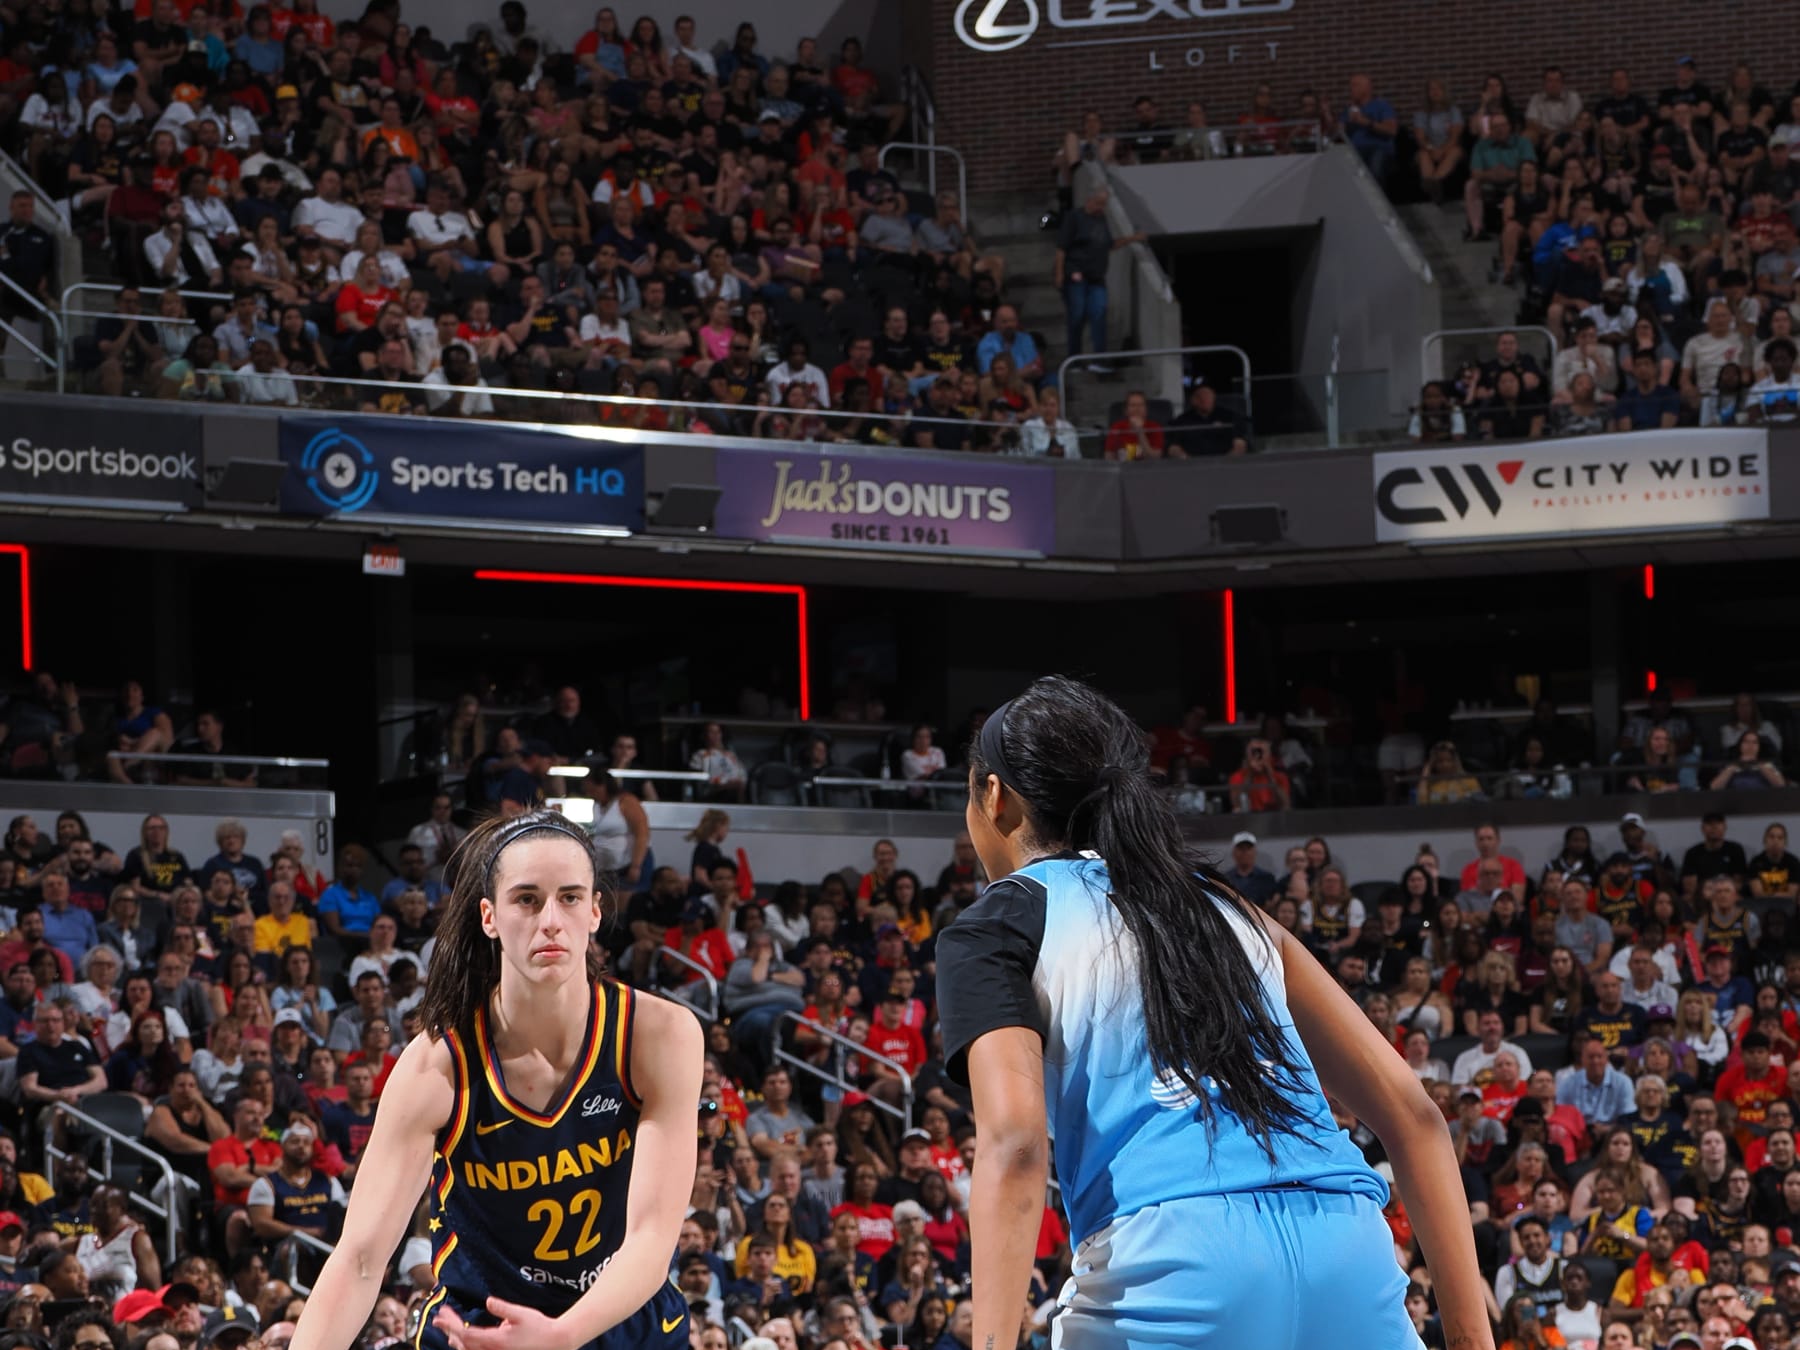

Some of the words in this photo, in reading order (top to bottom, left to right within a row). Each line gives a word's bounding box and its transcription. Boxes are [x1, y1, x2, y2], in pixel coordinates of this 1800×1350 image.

[1149, 42, 1280, 71] LOFT
[11, 437, 198, 480] Sportsbook
[390, 456, 495, 493] Sports
[498, 463, 568, 494] Tech
[575, 466, 627, 496] HQ
[1532, 461, 1630, 489] CITY
[1648, 453, 1760, 481] WIDE
[1531, 493, 1630, 508] FACILITY
[1643, 484, 1763, 503] SOLUTIONS
[830, 522, 891, 542] SINCE
[901, 525, 951, 546] 1961
[315, 819, 329, 857] 8
[581, 1094, 623, 1118] Lilly
[464, 1127, 632, 1192] INDIANA
[526, 1188, 603, 1262] 22
